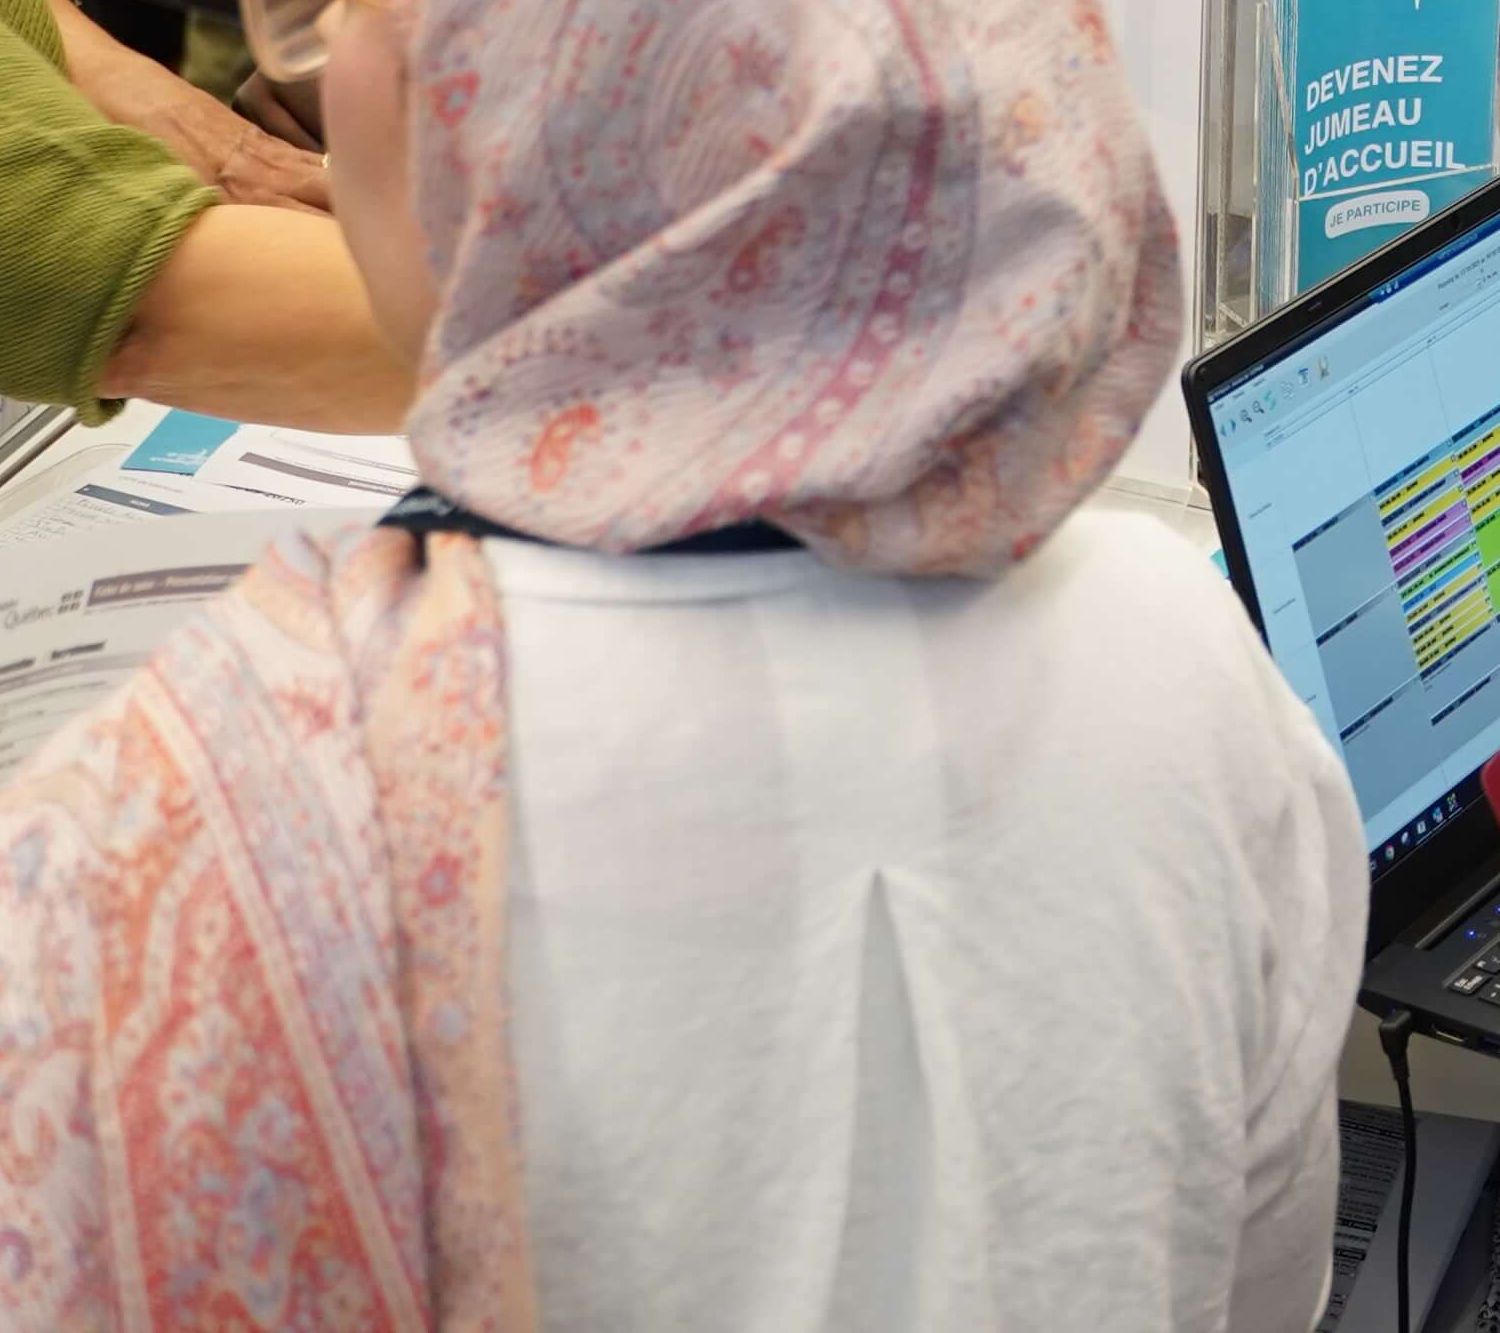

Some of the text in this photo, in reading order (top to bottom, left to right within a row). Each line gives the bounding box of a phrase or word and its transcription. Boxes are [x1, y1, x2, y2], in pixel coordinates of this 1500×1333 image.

[1306, 55, 1443, 112] DEVENEZ
[1304, 97, 1422, 155] JUMEAU
[1303, 140, 1465, 198] D'ACCUEIL
[1330, 199, 1421, 228] JE PARTICIPE
